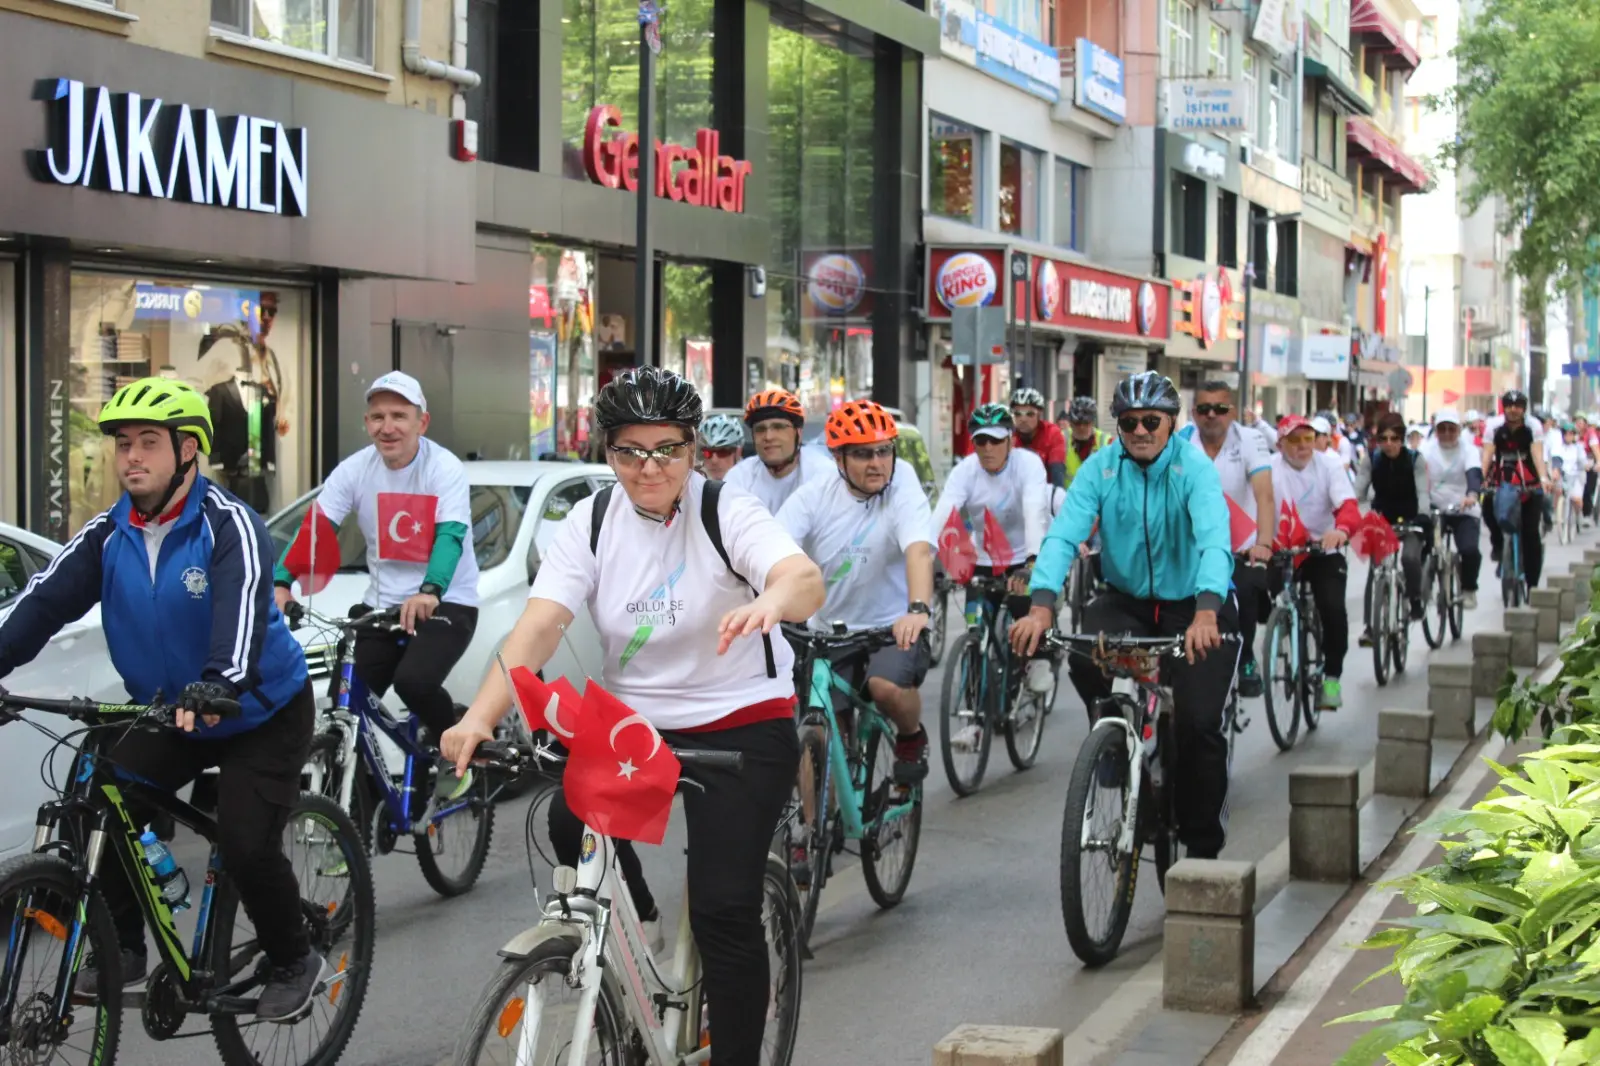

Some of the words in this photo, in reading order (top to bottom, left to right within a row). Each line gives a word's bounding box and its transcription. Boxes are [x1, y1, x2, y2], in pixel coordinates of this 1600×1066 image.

[1186, 100, 1229, 115] İŞİTME
[1173, 116, 1242, 128] CİHAZLARI
[47, 78, 307, 216] JAKAMEN
[942, 264, 985, 286] BURGER
[944, 272, 987, 300] KING
[1070, 278, 1107, 319] BURGER
[1108, 286, 1132, 323] KING
[50, 380, 63, 528] JAKAMEN
[635, 613, 666, 625] İZMİT
